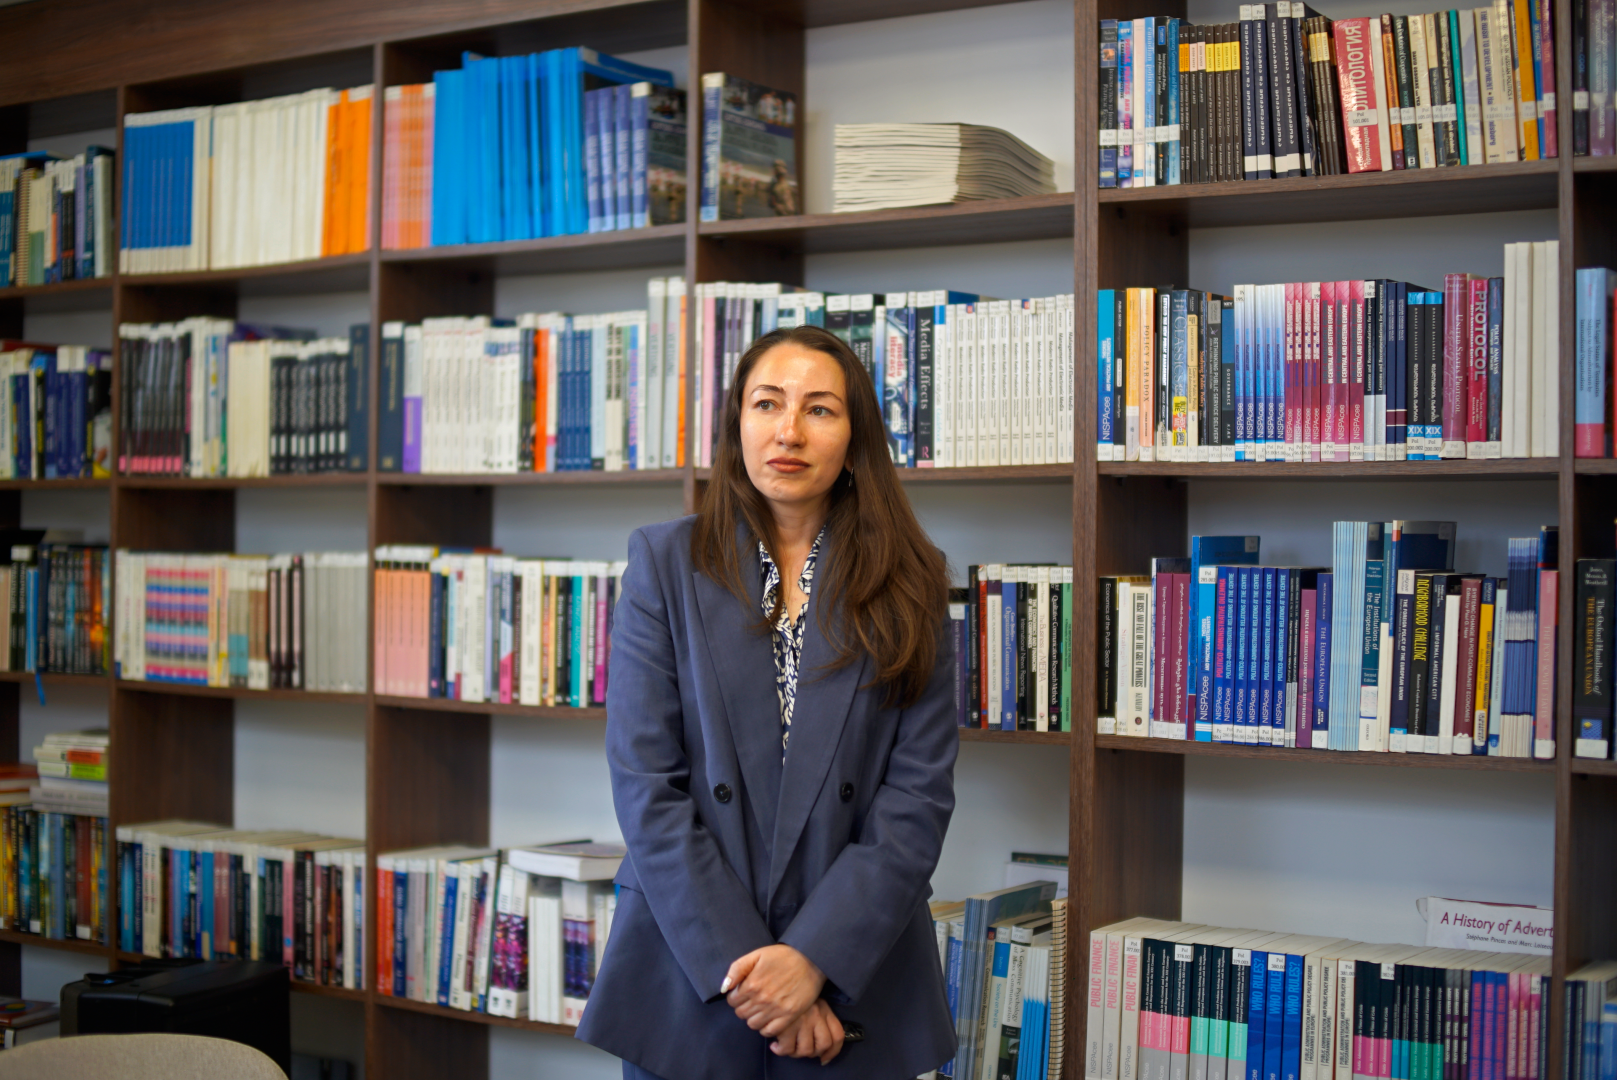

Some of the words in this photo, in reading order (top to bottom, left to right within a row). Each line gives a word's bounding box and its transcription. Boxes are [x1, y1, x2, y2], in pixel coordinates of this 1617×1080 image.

[1145, 65, 1154, 92] politics
[1345, 25, 1368, 110] ОЛИТОЛОГИЯ
[920, 319, 931, 360] Media
[1455, 314, 1464, 344] UNITED
[1474, 291, 1488, 381] PROTOCOL
[888, 336, 897, 378] literacy
[1455, 346, 1464, 374] STATES
[920, 366, 931, 410] Effects
[1174, 402, 1180, 412] ME
[1408, 426, 1424, 434] XIX
[1426, 426, 1442, 434] XIX
[1415, 579, 1429, 626] NEIGHBORHOOD
[1588, 597, 1596, 616] THE
[1597, 600, 1605, 615] The
[1364, 605, 1372, 634] European
[1372, 606, 1380, 642] Institutions
[1595, 616, 1604, 645] Oxford
[1413, 628, 1428, 662] CHALLENGE
[1586, 617, 1594, 664] EUROPEAN
[1038, 656, 1046, 682] MEDIA
[1594, 646, 1604, 684] Handbook
[1584, 667, 1593, 696] UNION
[1440, 912, 1449, 925] A
[1453, 913, 1496, 934] History
[1498, 920, 1513, 935] of
[1091, 940, 1103, 974] FINANCE
[1108, 940, 1120, 976] FINANCE
[1126, 955, 1138, 978] FINAN
[1252, 958, 1265, 990] RULES?
[1270, 972, 1282, 994] RULE
[1287, 962, 1300, 994] RULES?
[1090, 978, 1102, 1008] PUBLIC
[1106, 979, 1118, 1008] PUBLIC
[1124, 982, 1137, 1011] PUBLIC
[1251, 992, 1264, 1011] WHO
[1269, 995, 1281, 1014] WHO
[1287, 996, 1298, 1015] WHO
